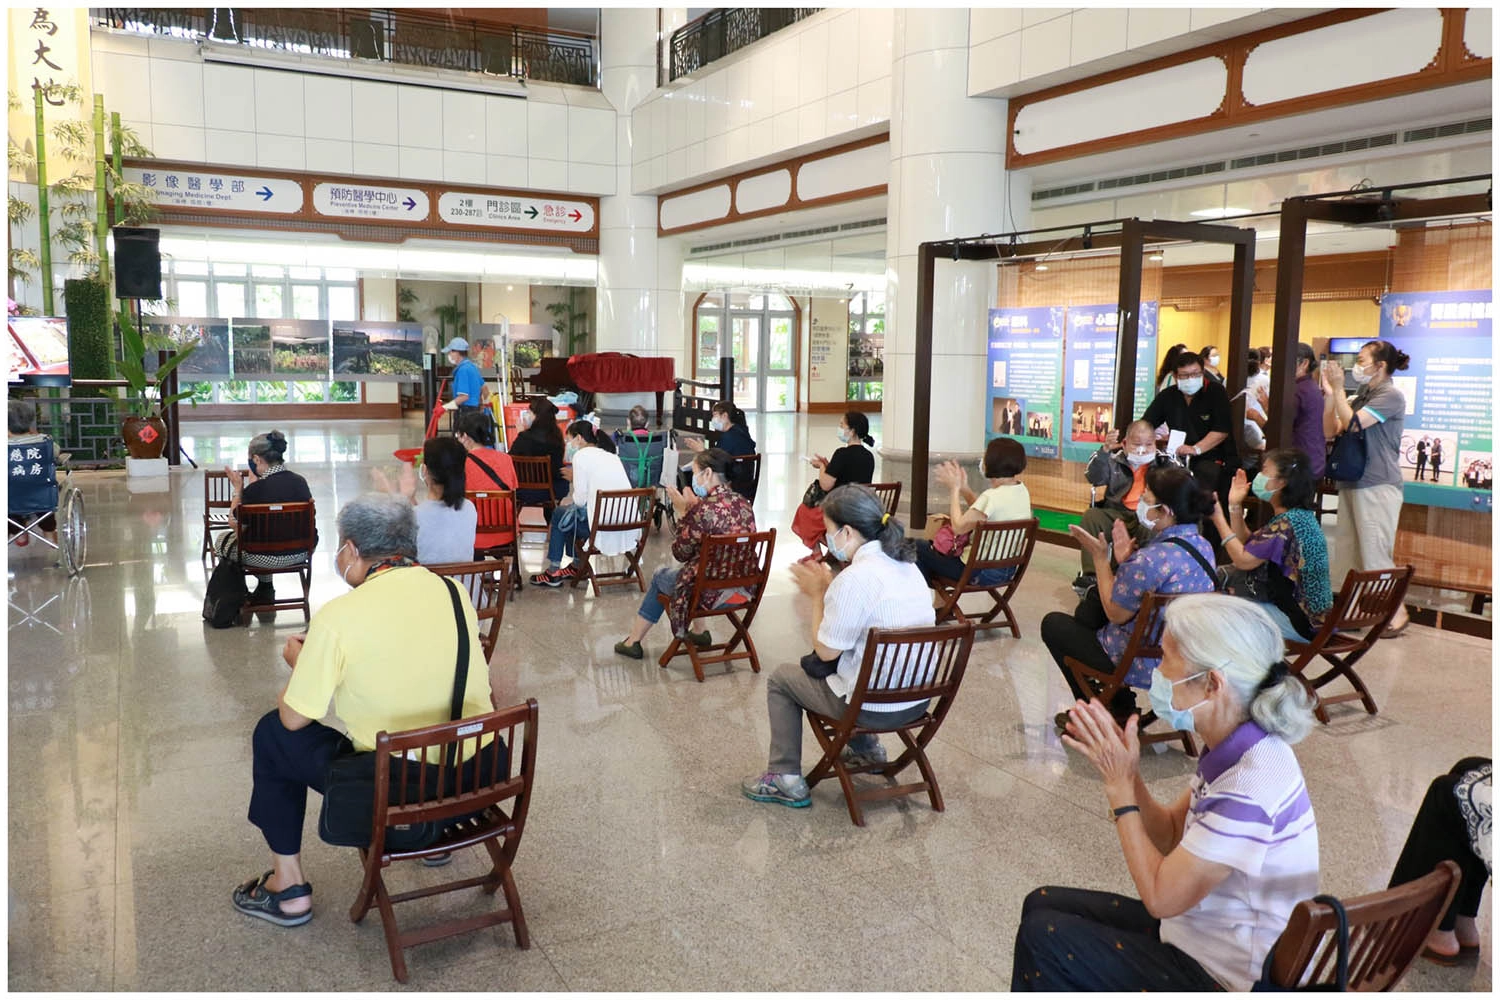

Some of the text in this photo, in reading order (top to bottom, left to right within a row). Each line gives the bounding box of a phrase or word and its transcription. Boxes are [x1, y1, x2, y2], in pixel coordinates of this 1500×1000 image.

[142, 173, 245, 193] 影像醫學部
[184, 191, 214, 200] Medicine
[330, 187, 398, 205] 預防醫學中心
[487, 200, 521, 214] 門診區
[543, 204, 566, 217] 急診
[10, 447, 42, 462] 慈院
[12, 463, 43, 476] 病房
